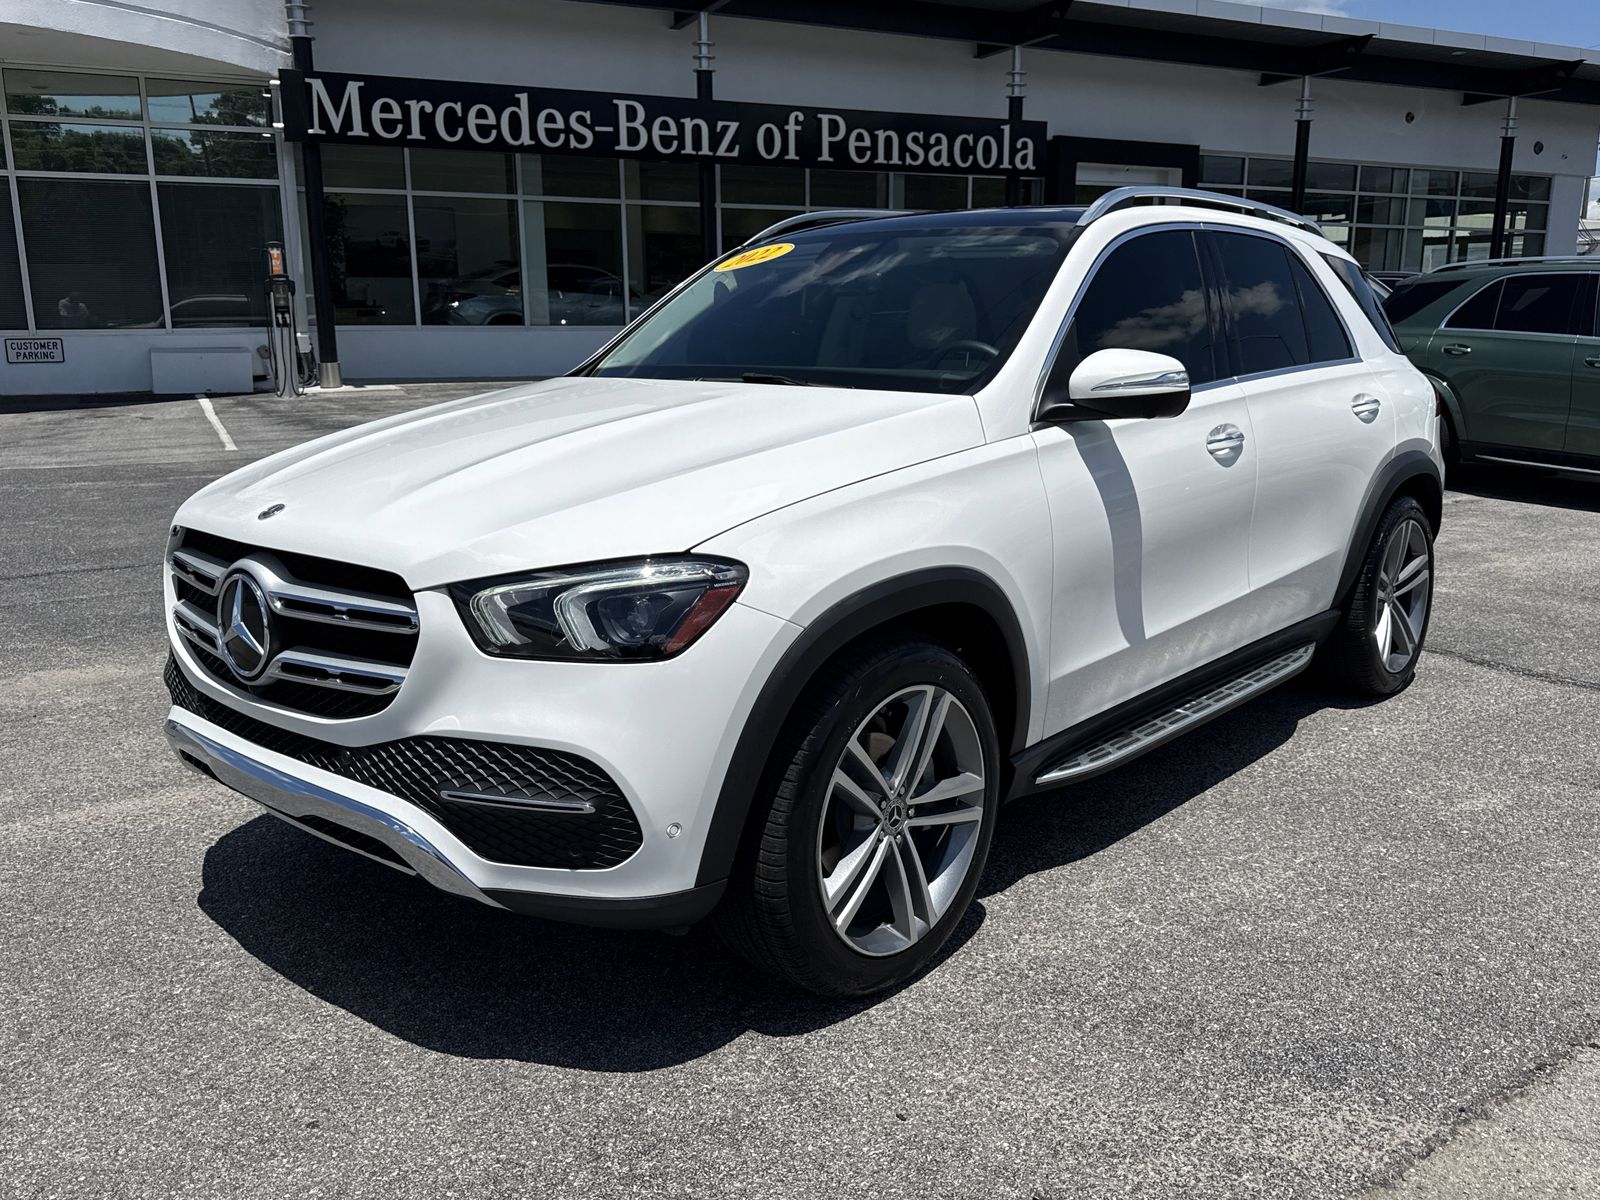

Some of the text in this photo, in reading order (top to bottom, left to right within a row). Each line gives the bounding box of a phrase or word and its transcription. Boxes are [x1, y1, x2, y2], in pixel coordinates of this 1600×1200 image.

[305, 77, 1037, 171] Mercedes-Benz of Pensacola
[720, 246, 784, 268] 2022
[10, 341, 58, 351] CUSTOMER
[16, 351, 55, 360] PARKING
